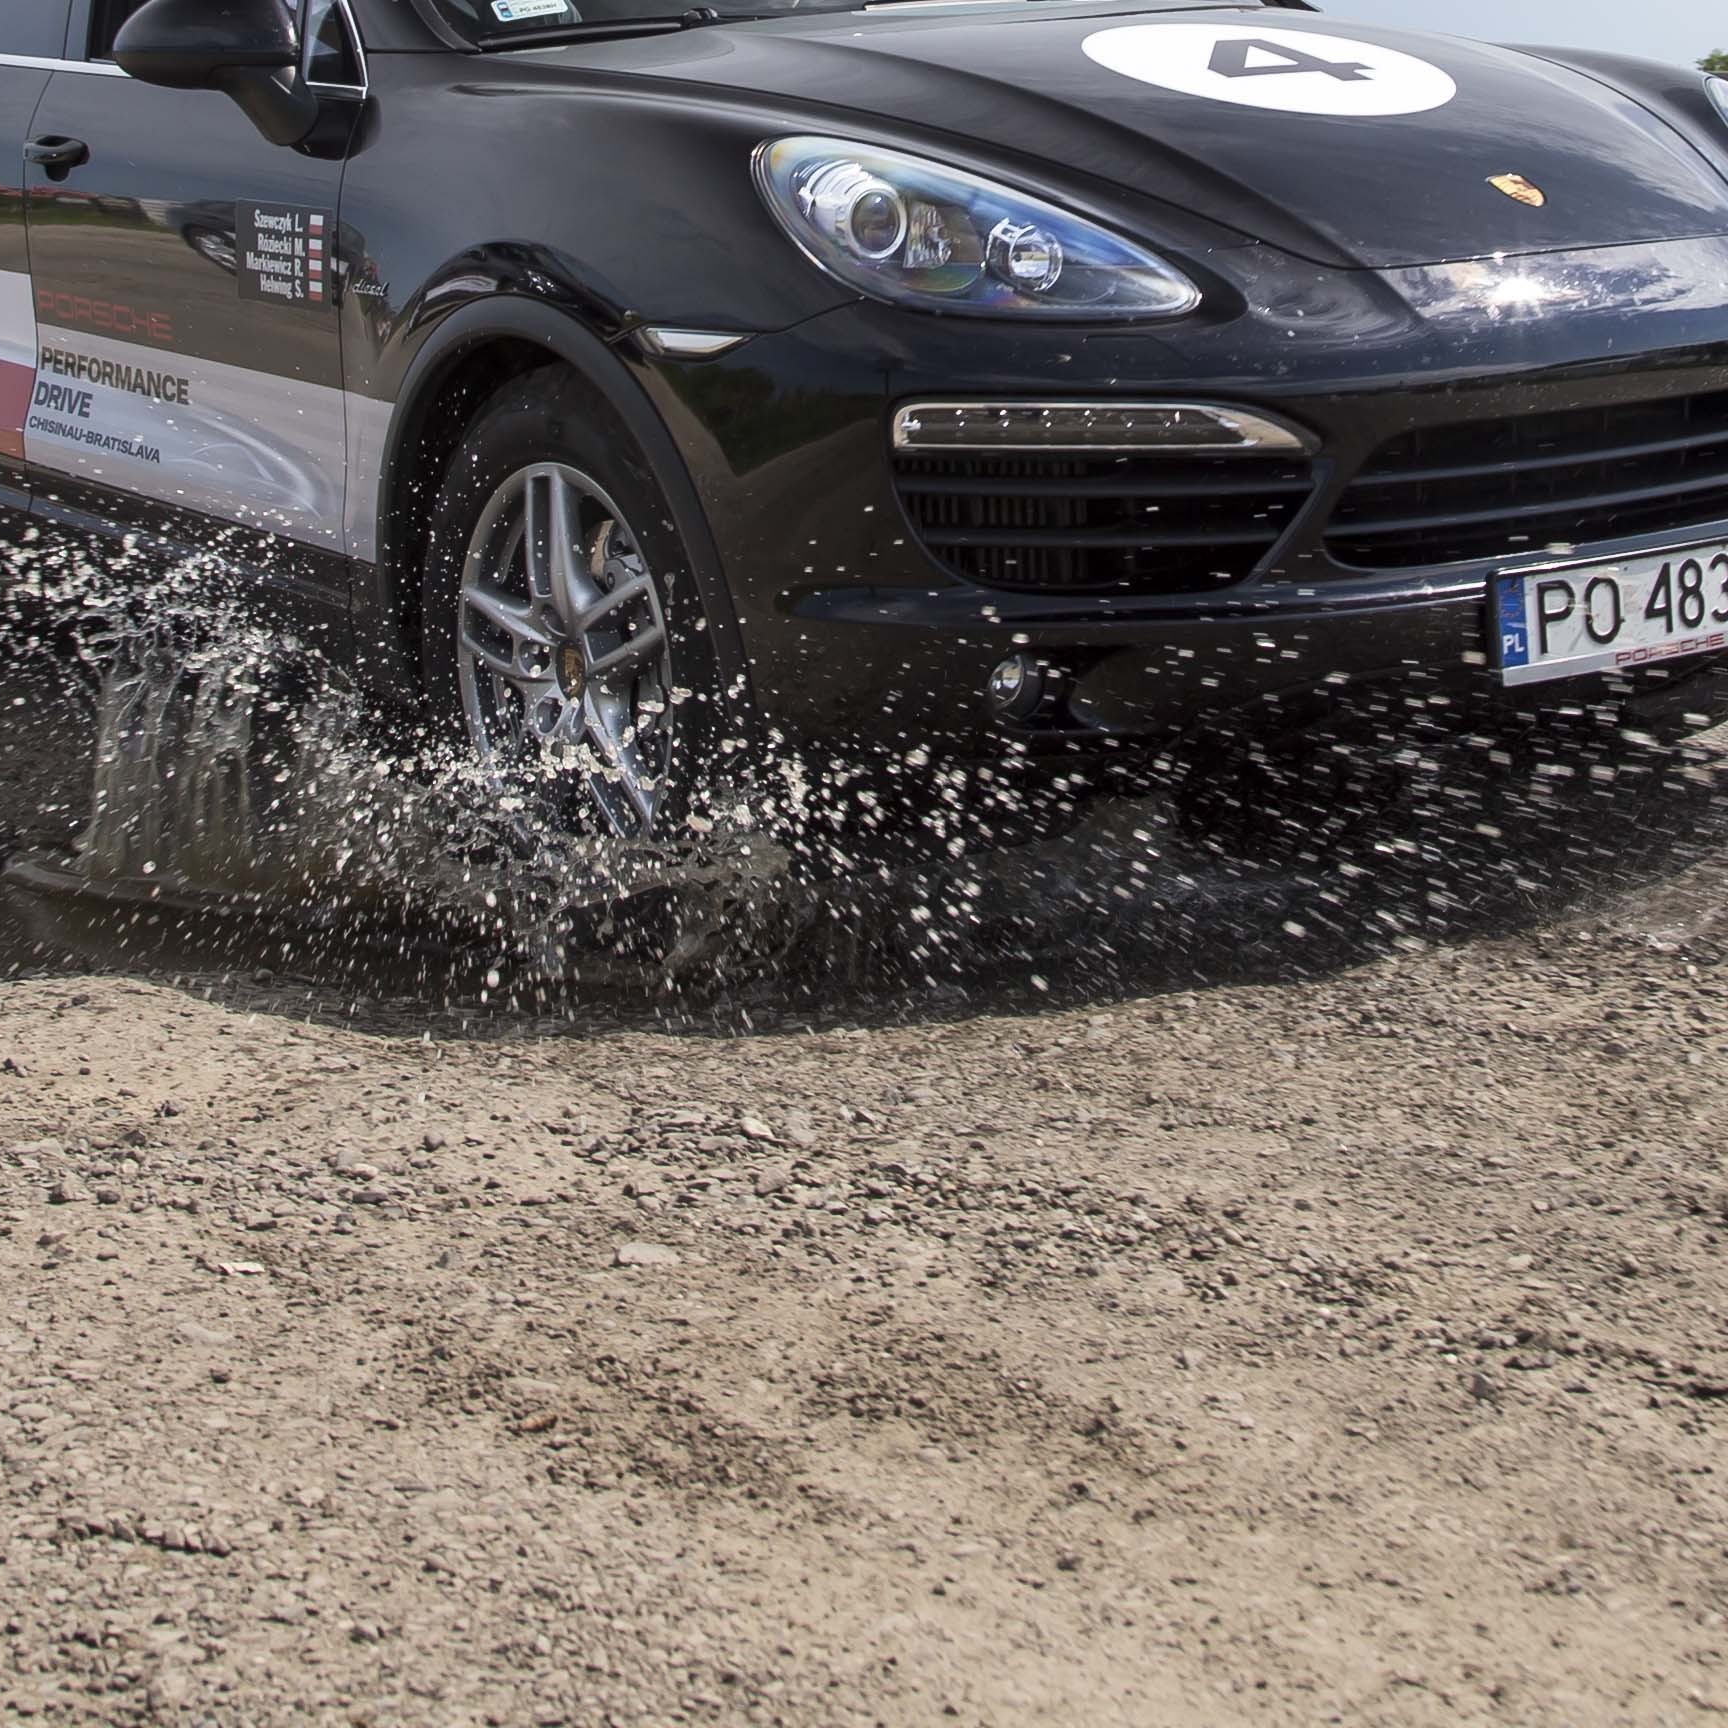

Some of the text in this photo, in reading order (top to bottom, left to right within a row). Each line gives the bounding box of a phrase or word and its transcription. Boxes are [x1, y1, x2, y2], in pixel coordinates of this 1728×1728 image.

[1207, 38, 1376, 82] 4
[254, 209, 304, 234] Szewczyk L.
[246, 251, 304, 277] Markiewicz R.
[294, 237, 306, 257] M.
[294, 279, 304, 298] S.
[352, 279, 390, 297] diesel
[37, 290, 174, 341] PORSCHE
[41, 346, 190, 406] PERFORMANCE
[34, 380, 93, 419] DRIVE
[28, 415, 160, 463] CHISINAU-BRATISLAVA
[1502, 634, 1525, 656] PL
[1536, 576, 1623, 655] PO
[1615, 633, 1725, 666] PORSCHE
